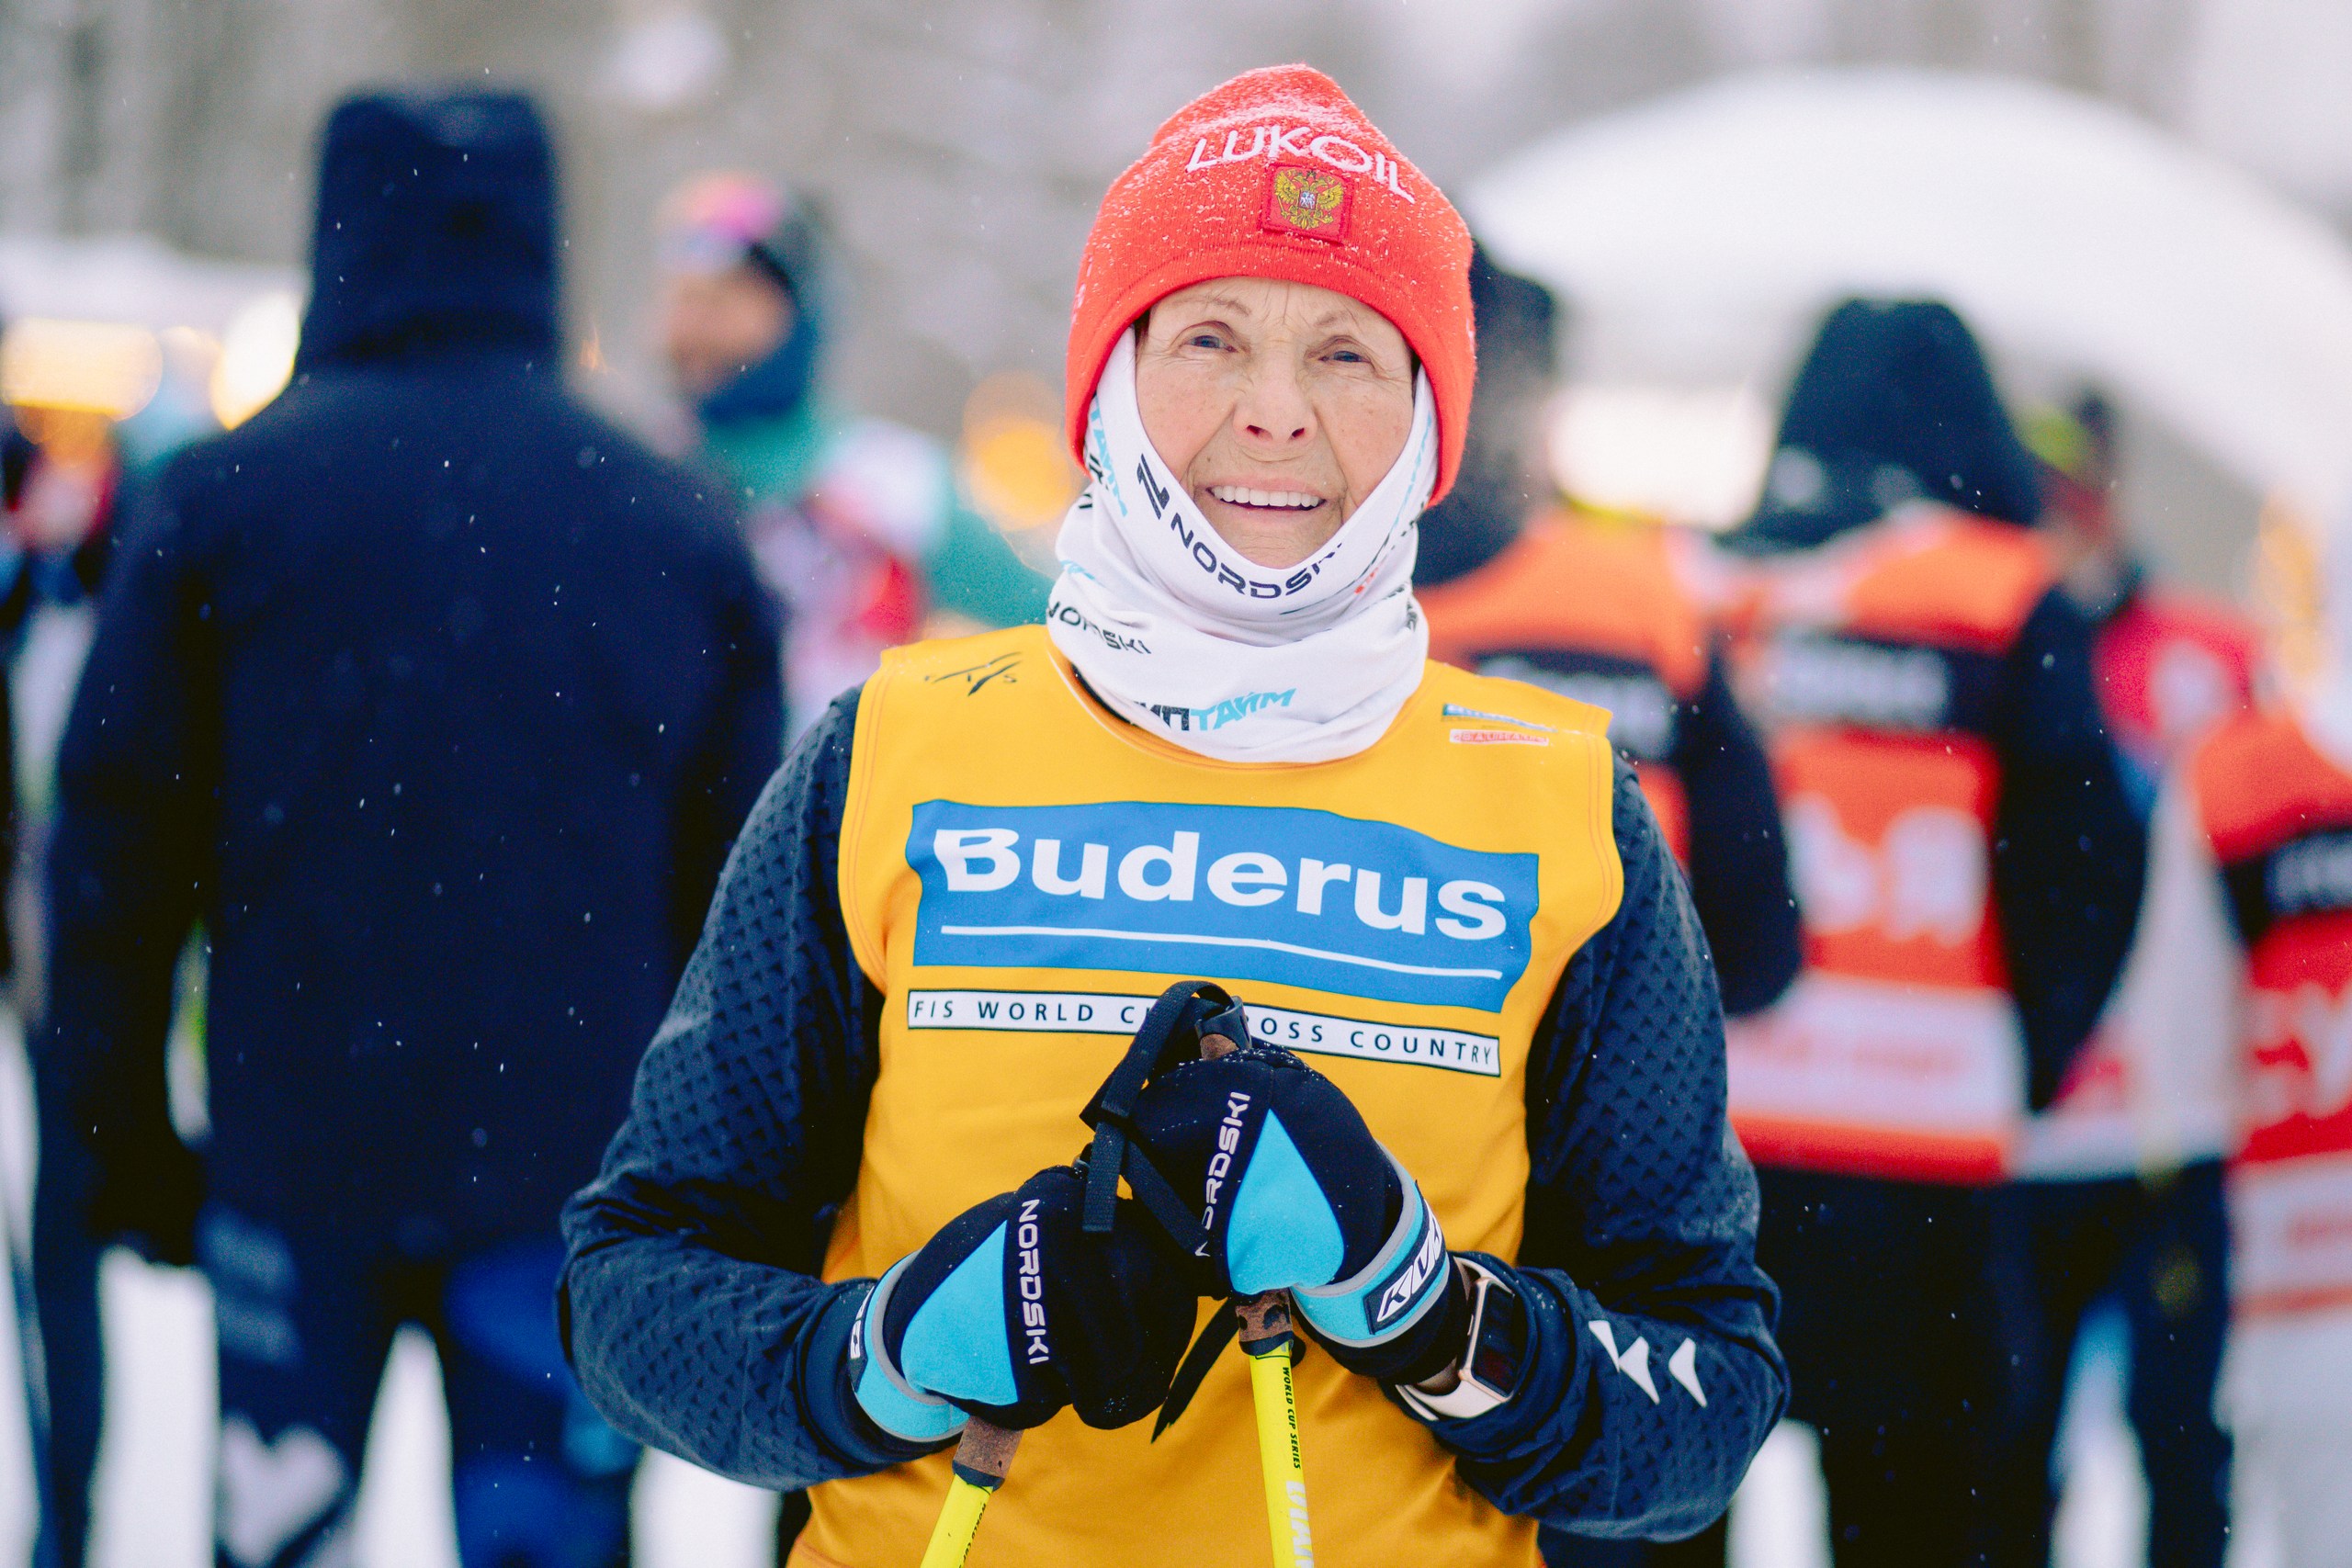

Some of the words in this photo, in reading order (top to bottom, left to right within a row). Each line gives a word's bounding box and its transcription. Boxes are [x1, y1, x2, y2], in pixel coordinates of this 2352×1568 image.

[1185, 126, 1415, 204] LUKOIL
[1170, 513, 1342, 598] NORDS
[933, 829, 1507, 941] Buderus
[914, 1000, 954, 1018] FIS
[978, 1001, 1093, 1021] WORLD
[1245, 1015, 1323, 1043] OSS
[1350, 1031, 1491, 1065] COUNTRY
[1018, 1199, 1050, 1365] NORDSKI
[1283, 1366, 1294, 1404] WORLD
[1287, 1408, 1296, 1430] CUP
[1290, 1433, 1301, 1470] SERIES
